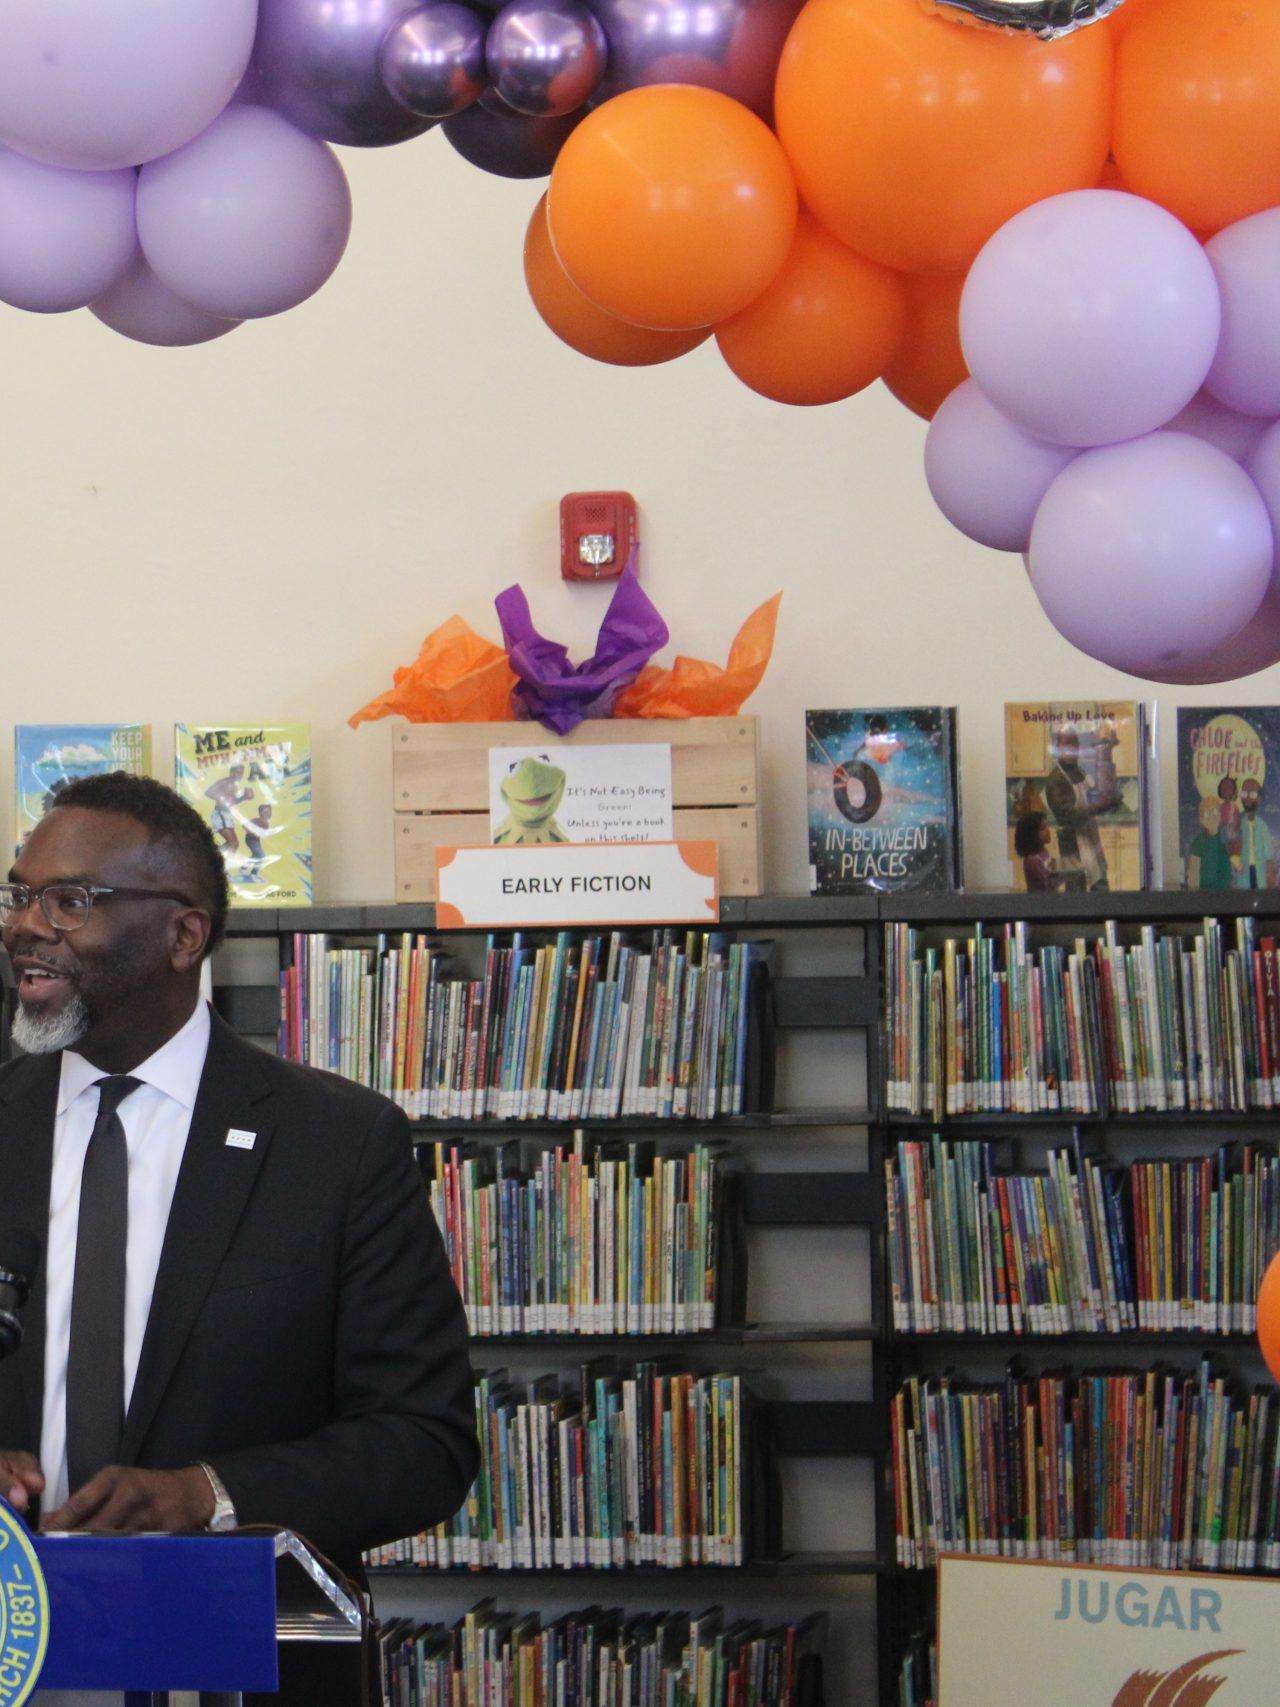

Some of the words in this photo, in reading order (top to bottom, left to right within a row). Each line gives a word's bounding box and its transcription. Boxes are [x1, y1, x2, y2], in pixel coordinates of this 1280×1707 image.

[194, 731, 230, 754] ME
[235, 731, 264, 747] and
[610, 786, 636, 798] Easy
[638, 785, 666, 798] Being
[567, 819, 600, 827] Unless
[825, 826, 928, 851] IN-BETWEEN
[840, 852, 908, 878] PLACES
[502, 877, 563, 894] EARLY
[571, 875, 651, 893] FICTION
[6, 1582, 36, 1639] 1837
[1055, 1578, 1222, 1633] JUGAR
